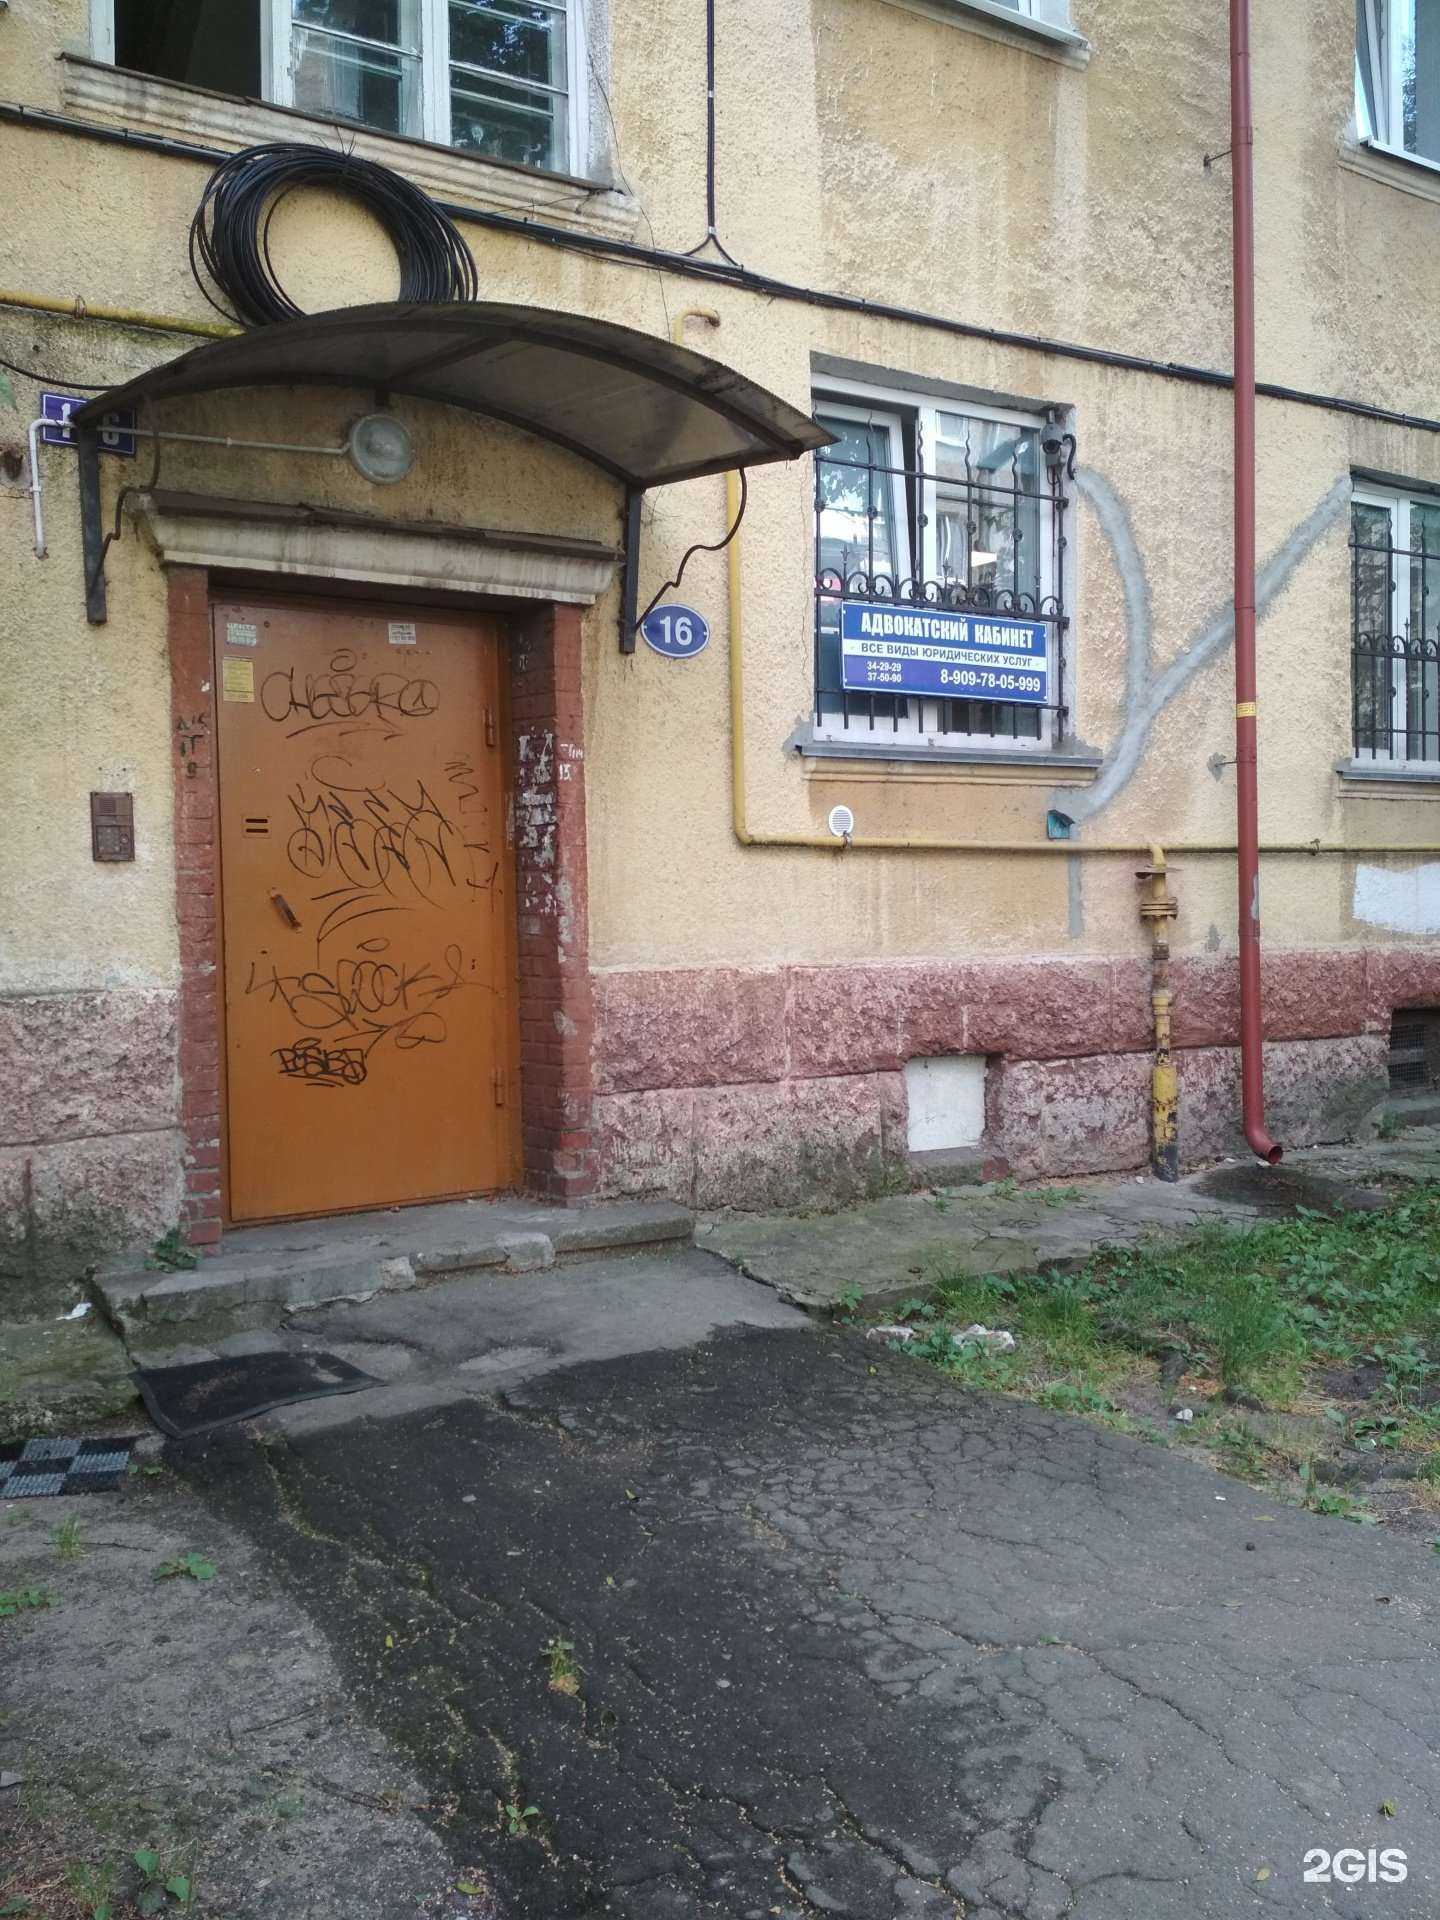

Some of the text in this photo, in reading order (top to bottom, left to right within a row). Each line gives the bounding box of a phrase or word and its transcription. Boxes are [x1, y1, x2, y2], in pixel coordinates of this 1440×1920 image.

[659, 616, 693, 646] 16
[861, 612, 1034, 649] АДВОКАТСКИЙ КАБИНЕТ
[861, 642, 1033, 668] ВСЕ ВИДЫ ЮРИДИЧЕСКИХ УСЛУГ
[866, 672, 902, 683] 37-50-90
[940, 668, 1041, 693] 8-909-78-05-999
